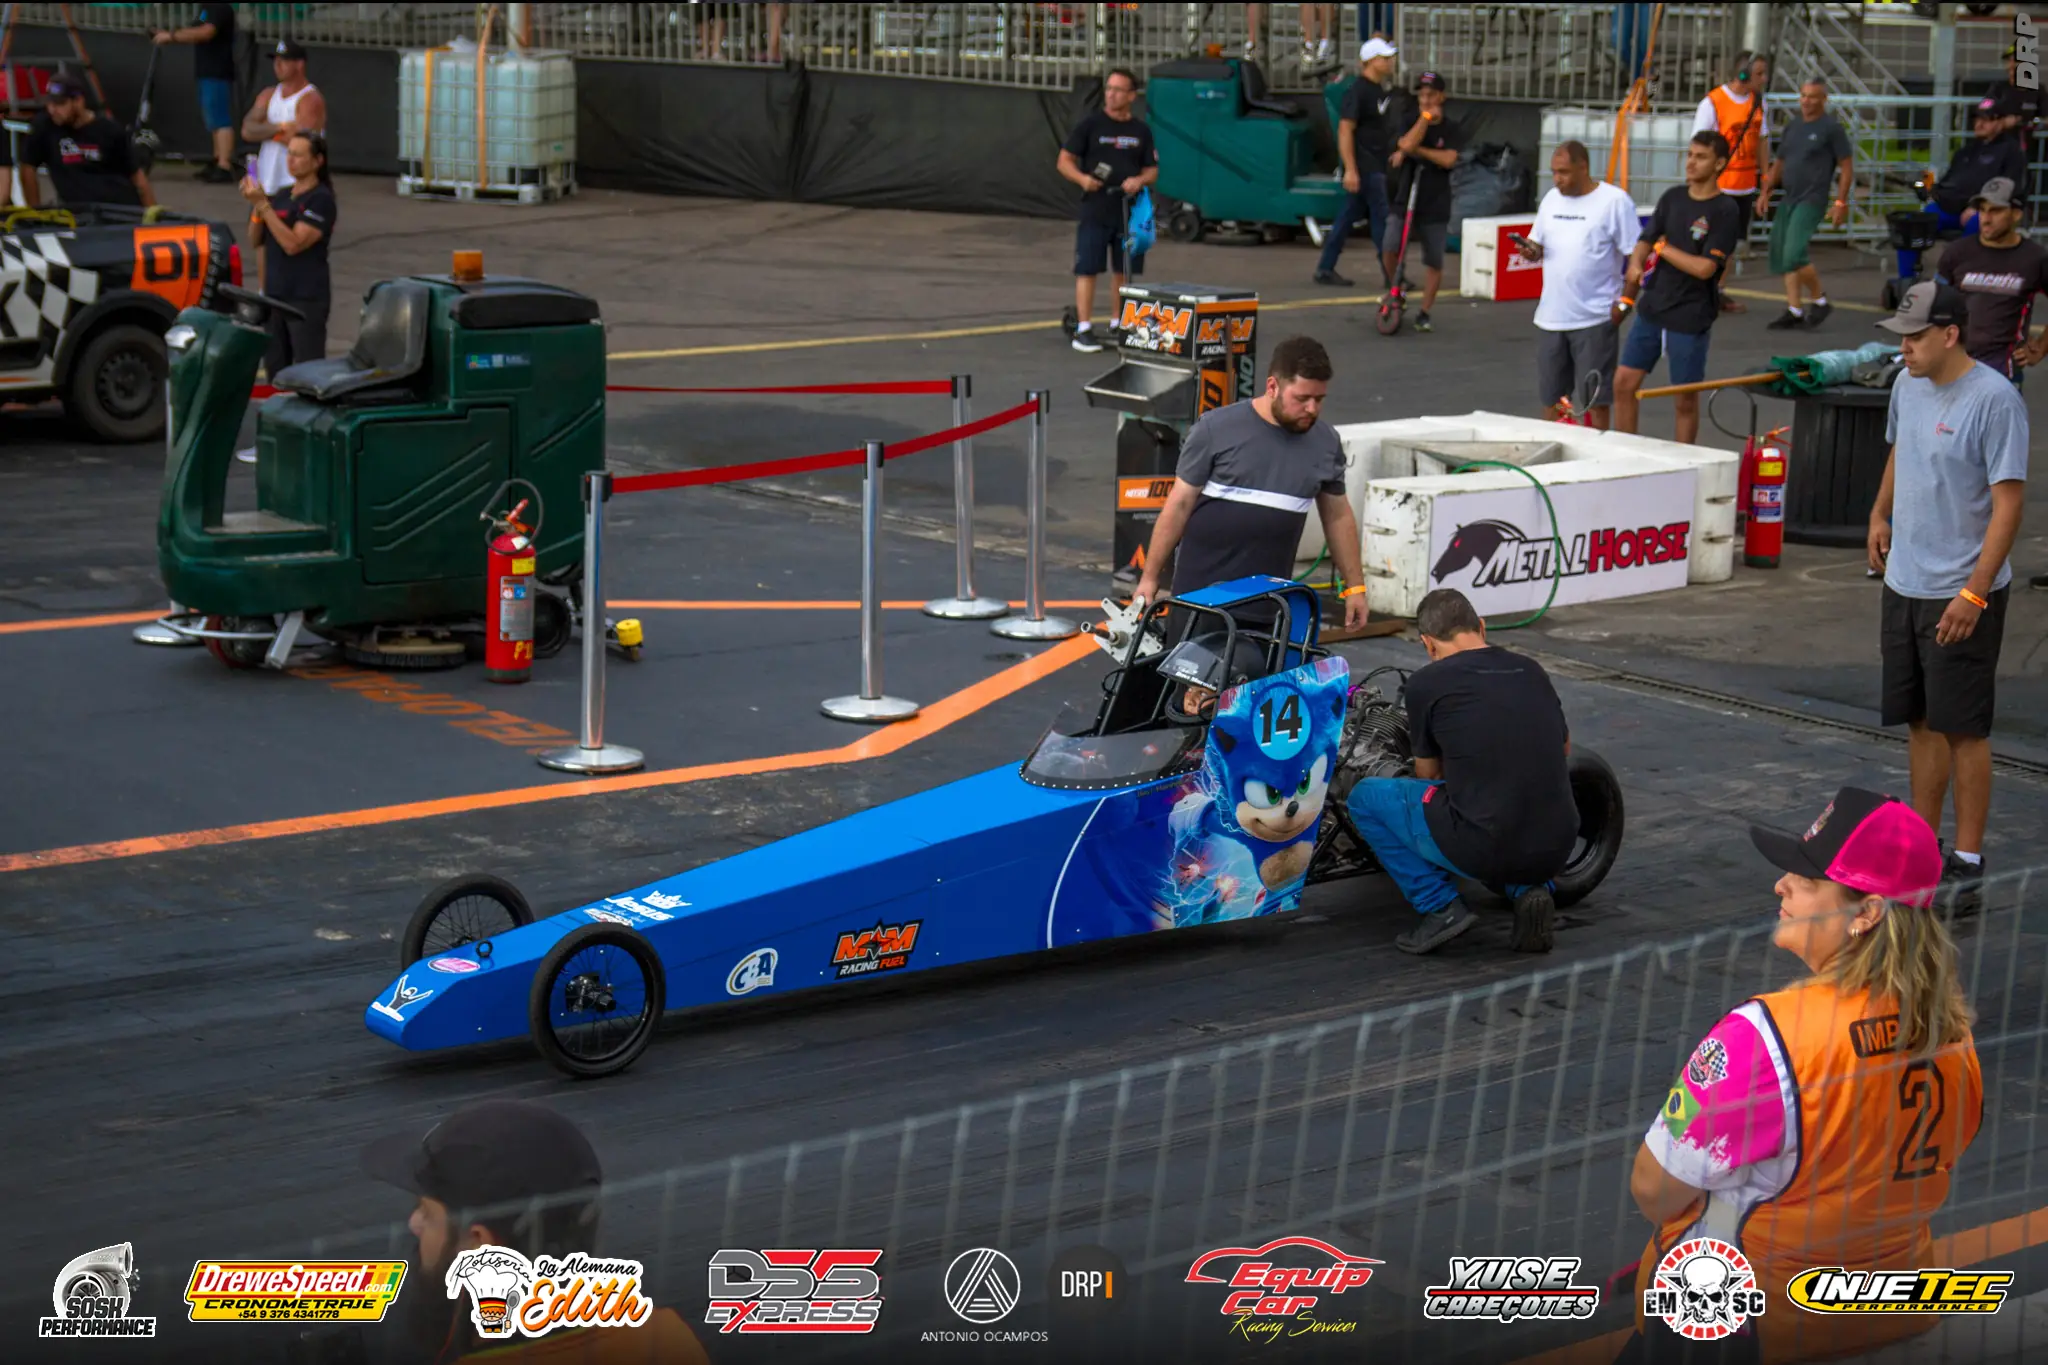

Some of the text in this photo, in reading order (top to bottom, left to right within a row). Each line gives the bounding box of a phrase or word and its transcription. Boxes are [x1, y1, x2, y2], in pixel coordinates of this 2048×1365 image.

[1259, 695, 1303, 746] 14
[604, 896, 675, 921] Jesus
[840, 956, 905, 975] RACING FUEL
[1893, 1058, 1945, 1182] 2
